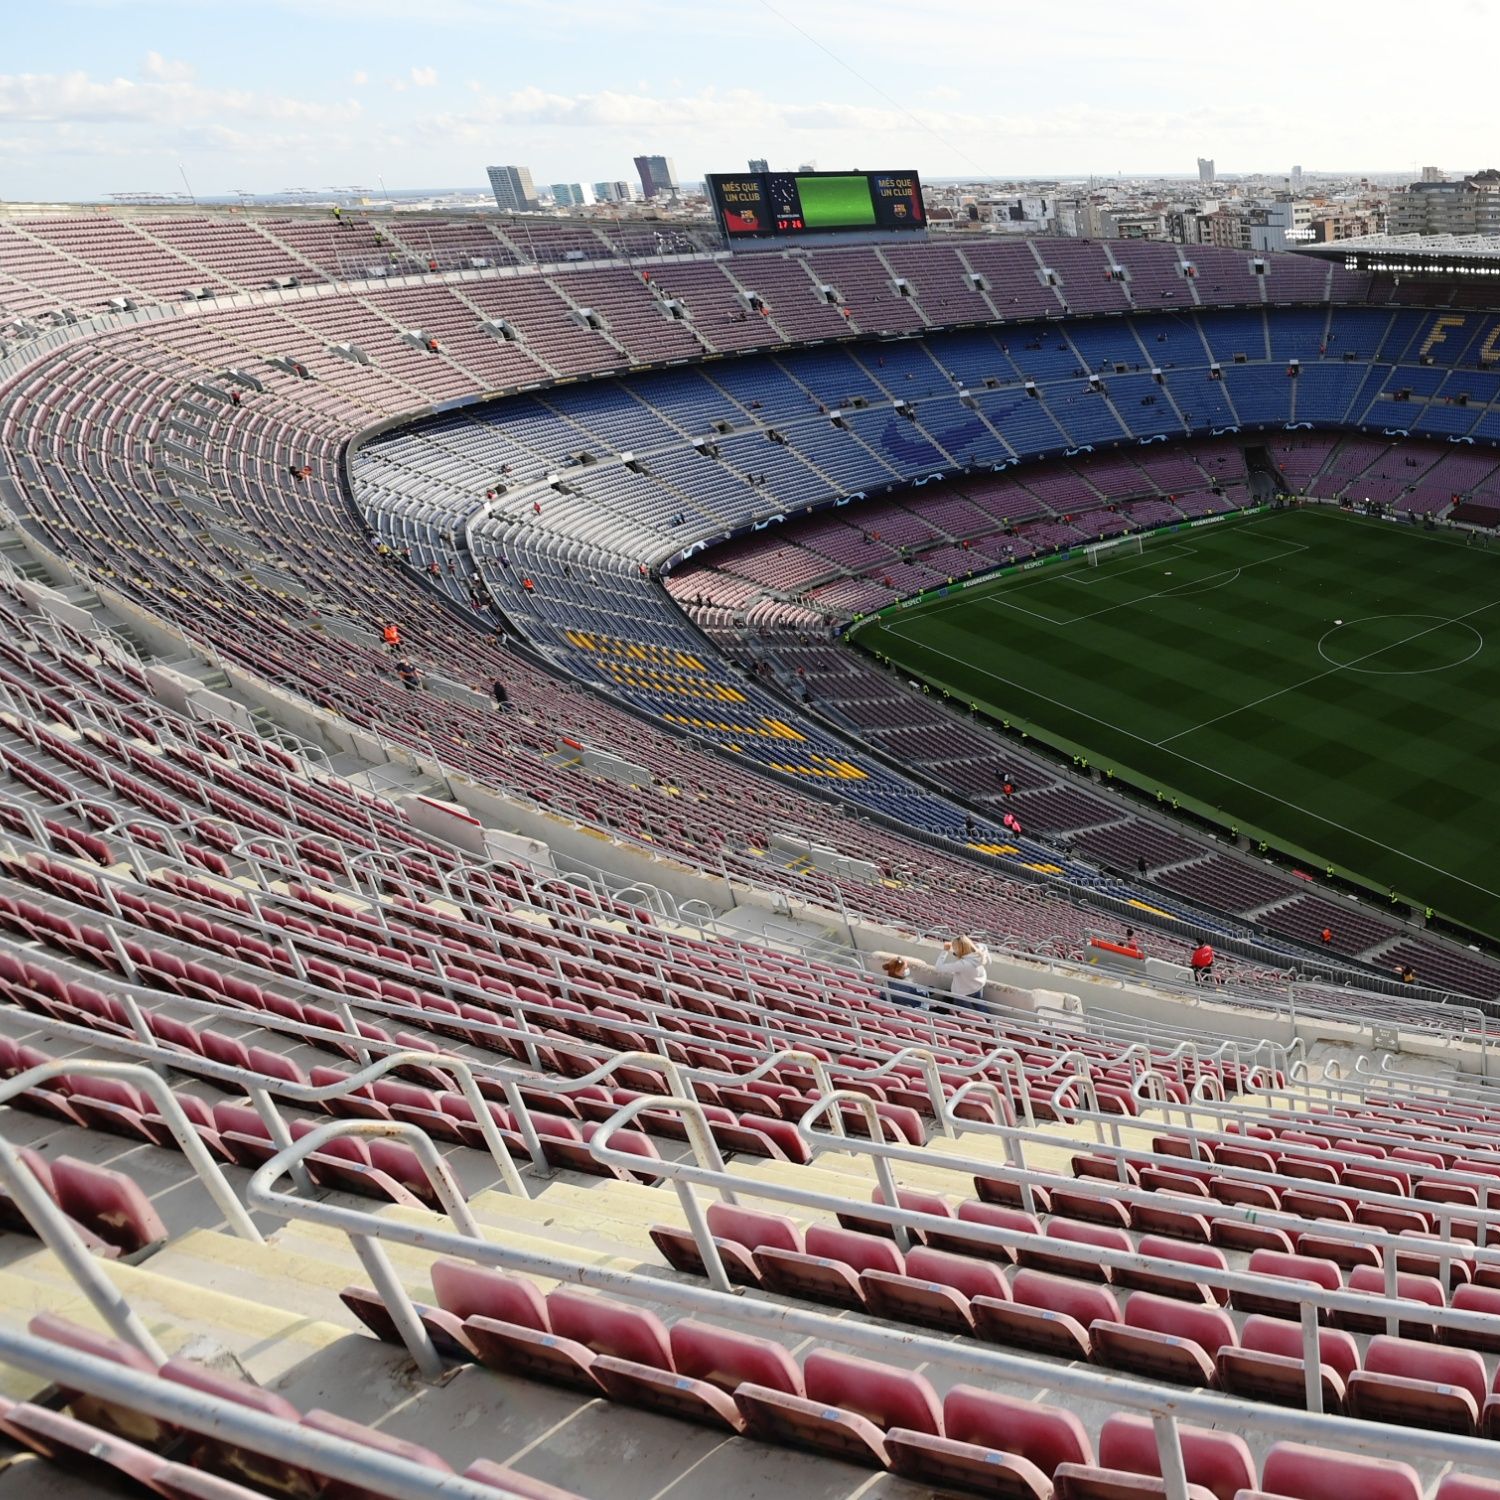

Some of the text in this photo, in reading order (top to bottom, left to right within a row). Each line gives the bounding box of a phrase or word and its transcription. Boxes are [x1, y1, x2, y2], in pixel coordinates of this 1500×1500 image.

[721, 181, 760, 192] MÉS QUE
[878, 178, 912, 188] MÉS QUE
[725, 192, 761, 202] UN CLUB
[881, 188, 913, 197] UN CLUB
[778, 221, 788, 230] 17
[963, 560, 1045, 588] #EUGREENDEAL RESPECT
[902, 596, 922, 609] RESPECT
